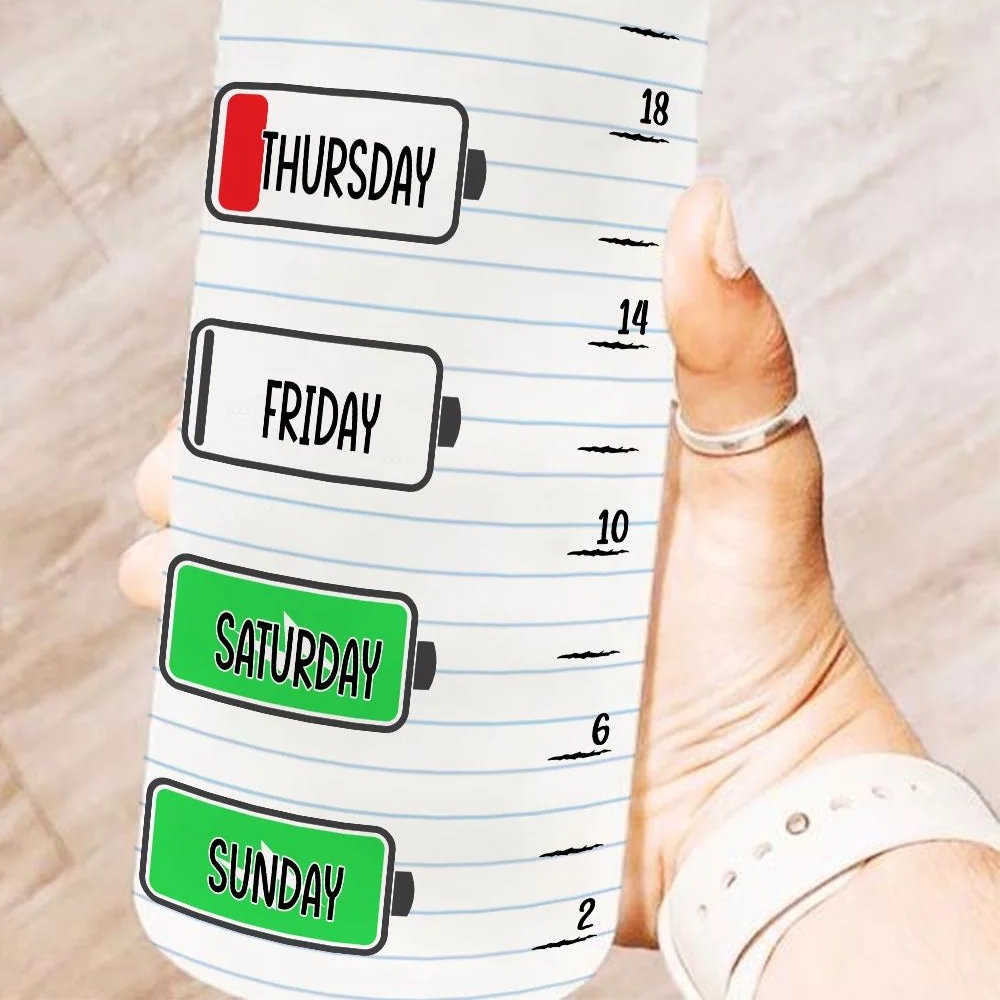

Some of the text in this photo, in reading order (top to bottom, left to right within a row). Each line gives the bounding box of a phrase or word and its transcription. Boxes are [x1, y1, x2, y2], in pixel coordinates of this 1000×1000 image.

[639, 87, 670, 126] 18
[261, 130, 436, 208] THURSDAY
[617, 299, 649, 336] 14
[262, 379, 381, 454] FRIDAY
[597, 509, 629, 545] 10
[214, 611, 383, 700] SATURDAY
[591, 713, 610, 745] 6
[207, 838, 345, 921] SUNDAY
[577, 898, 596, 930] 2
